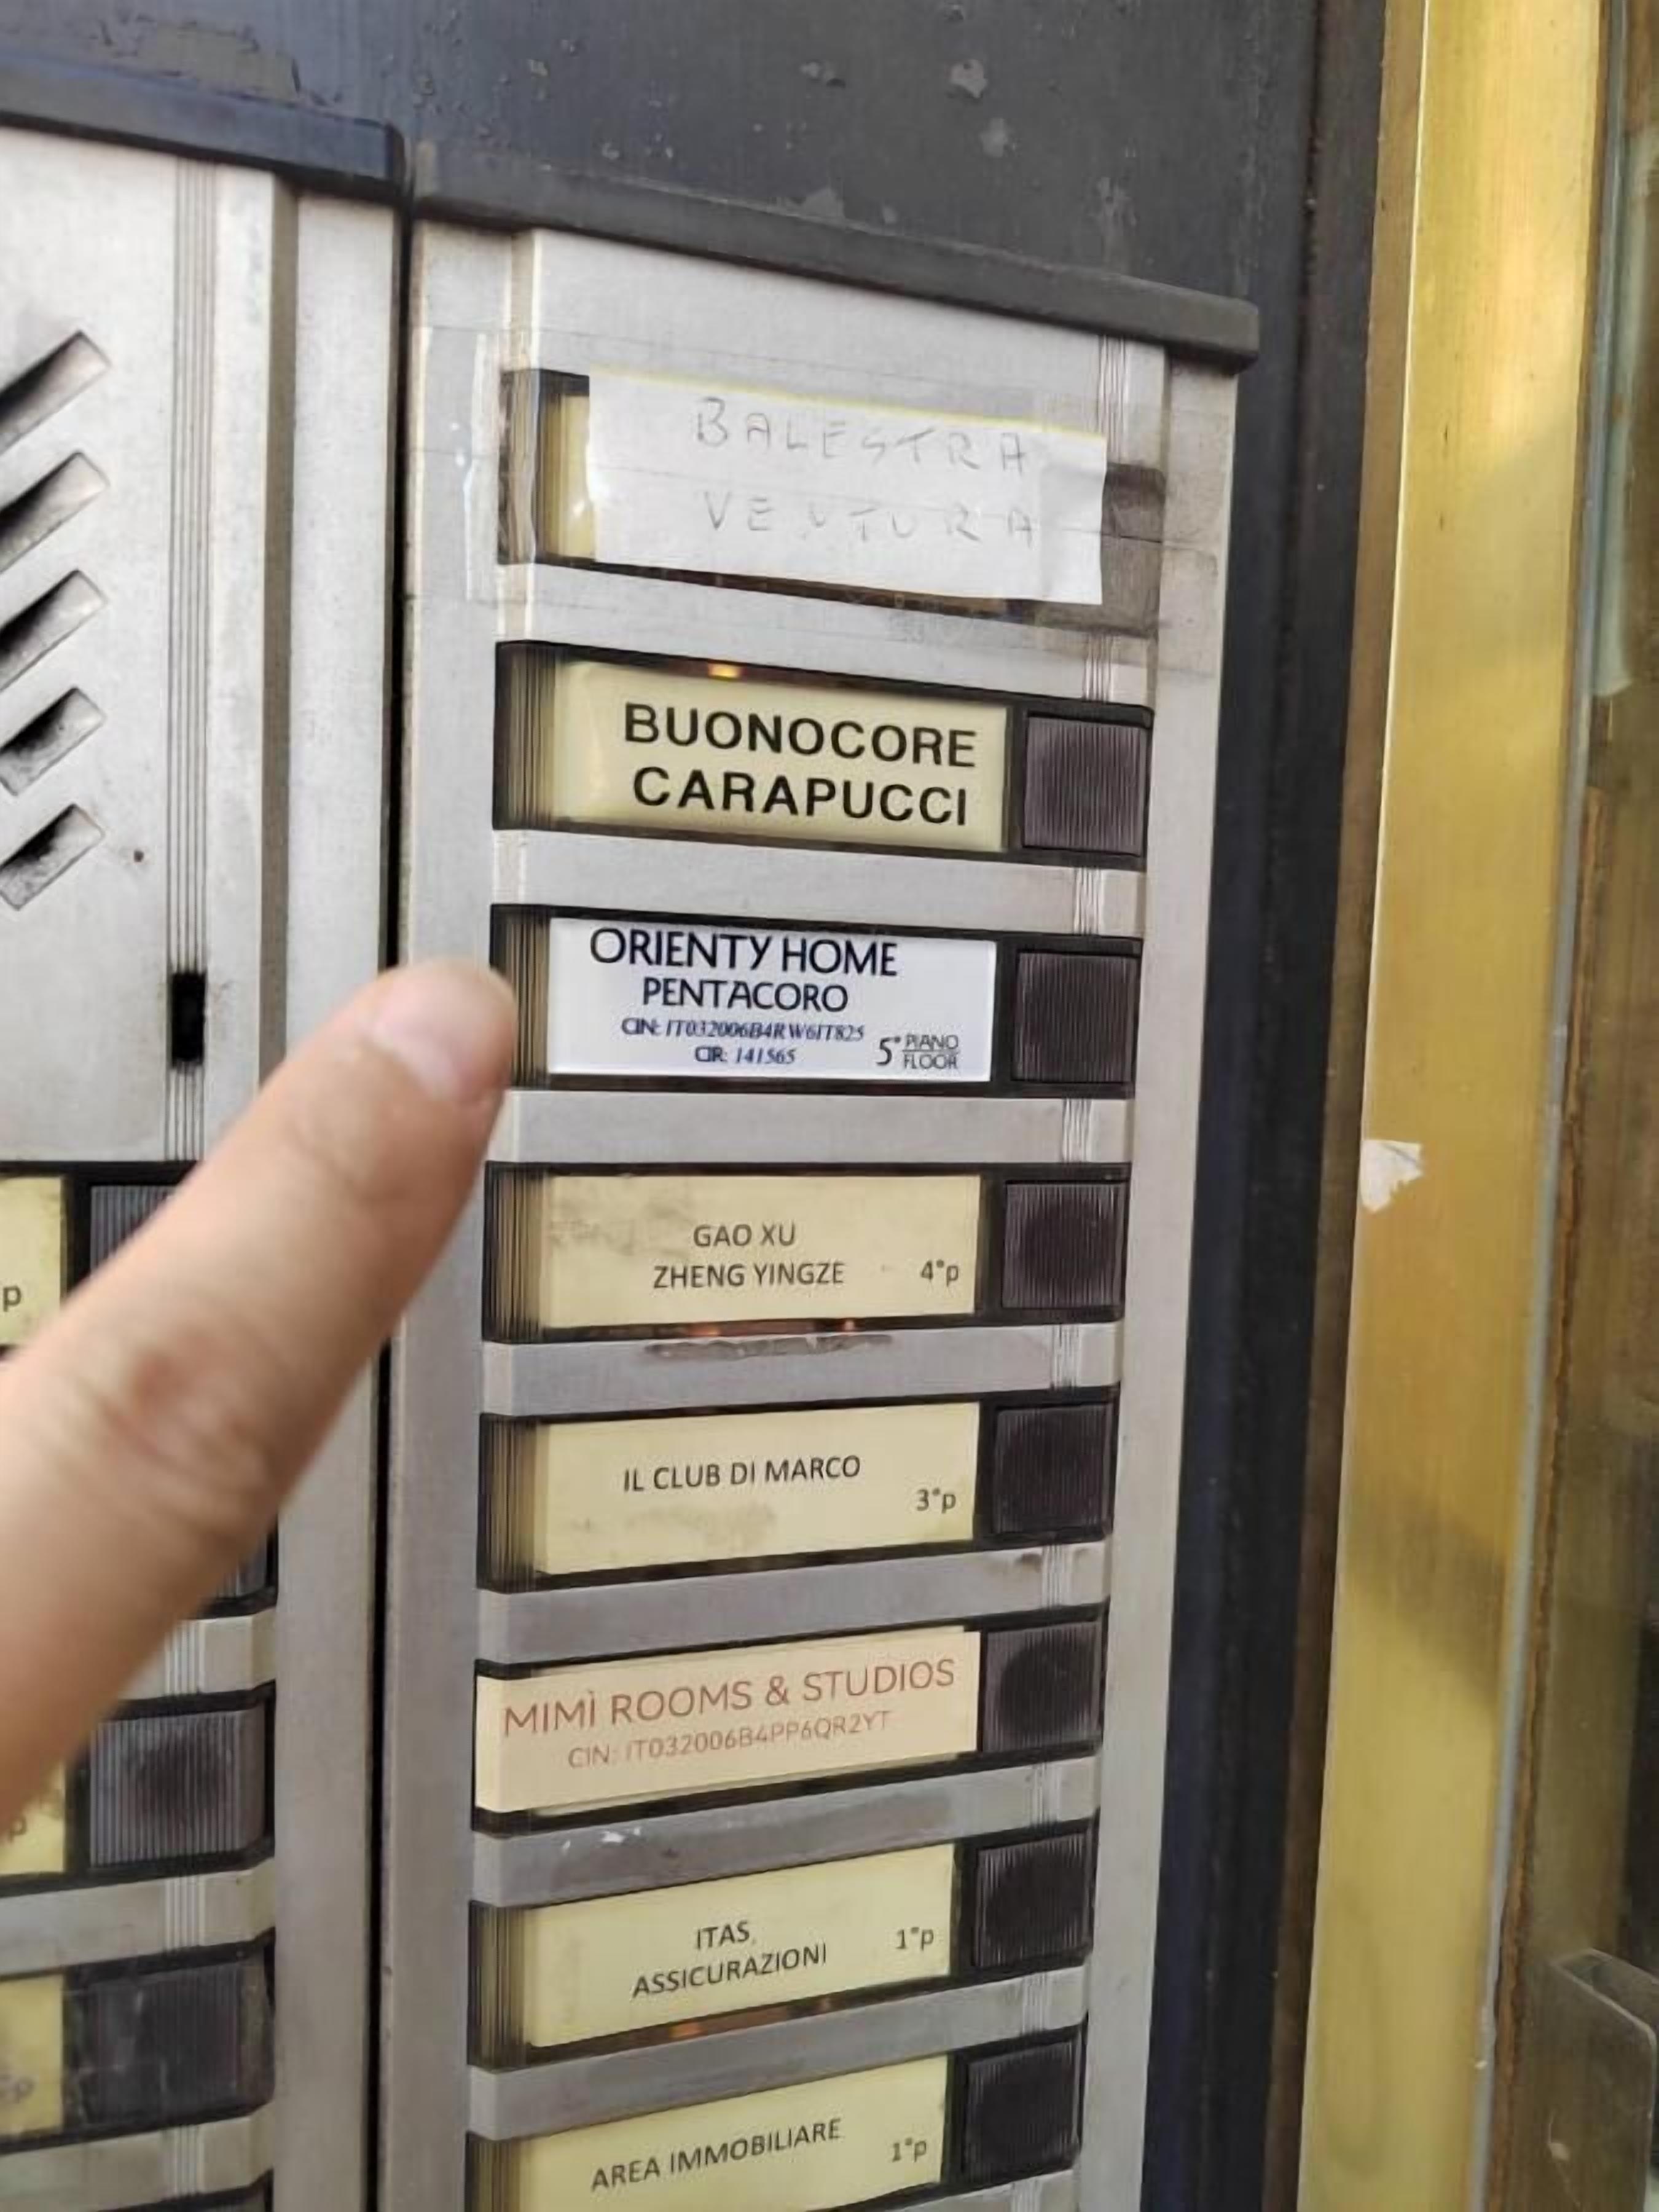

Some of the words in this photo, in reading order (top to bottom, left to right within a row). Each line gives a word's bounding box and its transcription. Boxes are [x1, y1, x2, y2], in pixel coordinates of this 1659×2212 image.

[696, 397, 1028, 474] BALESTRA
[624, 702, 977, 767] BUONOCORE
[632, 766, 967, 826] CARAPUCCI
[590, 927, 772, 971] ORIENTY
[782, 936, 898, 977] HOME
[643, 977, 849, 1013] PENTACORO
[735, 1046, 798, 1065] 141565
[903, 1053, 958, 1070] FLOOR
[906, 1033, 959, 1050] PIANO
[692, 1223, 752, 1248] GAO
[759, 1222, 796, 1247] XU
[653, 1263, 745, 1289] ZHENG
[752, 1261, 845, 1287] YINGZE
[623, 1468, 644, 1492] IL
[653, 1465, 721, 1490] CLUB
[730, 1461, 756, 1486] DI
[764, 1454, 861, 1483] MARCO
[503, 1690, 597, 1737] MIMÌ
[611, 1681, 753, 1725] ROOMS
[765, 1676, 790, 1707] &
[802, 1658, 955, 1703] STUDIOS
[631, 1943, 827, 1999] ASSICURAZIONI
[591, 2157, 660, 2192] AREA
[670, 2118, 842, 2173] IMMOBILIARE
